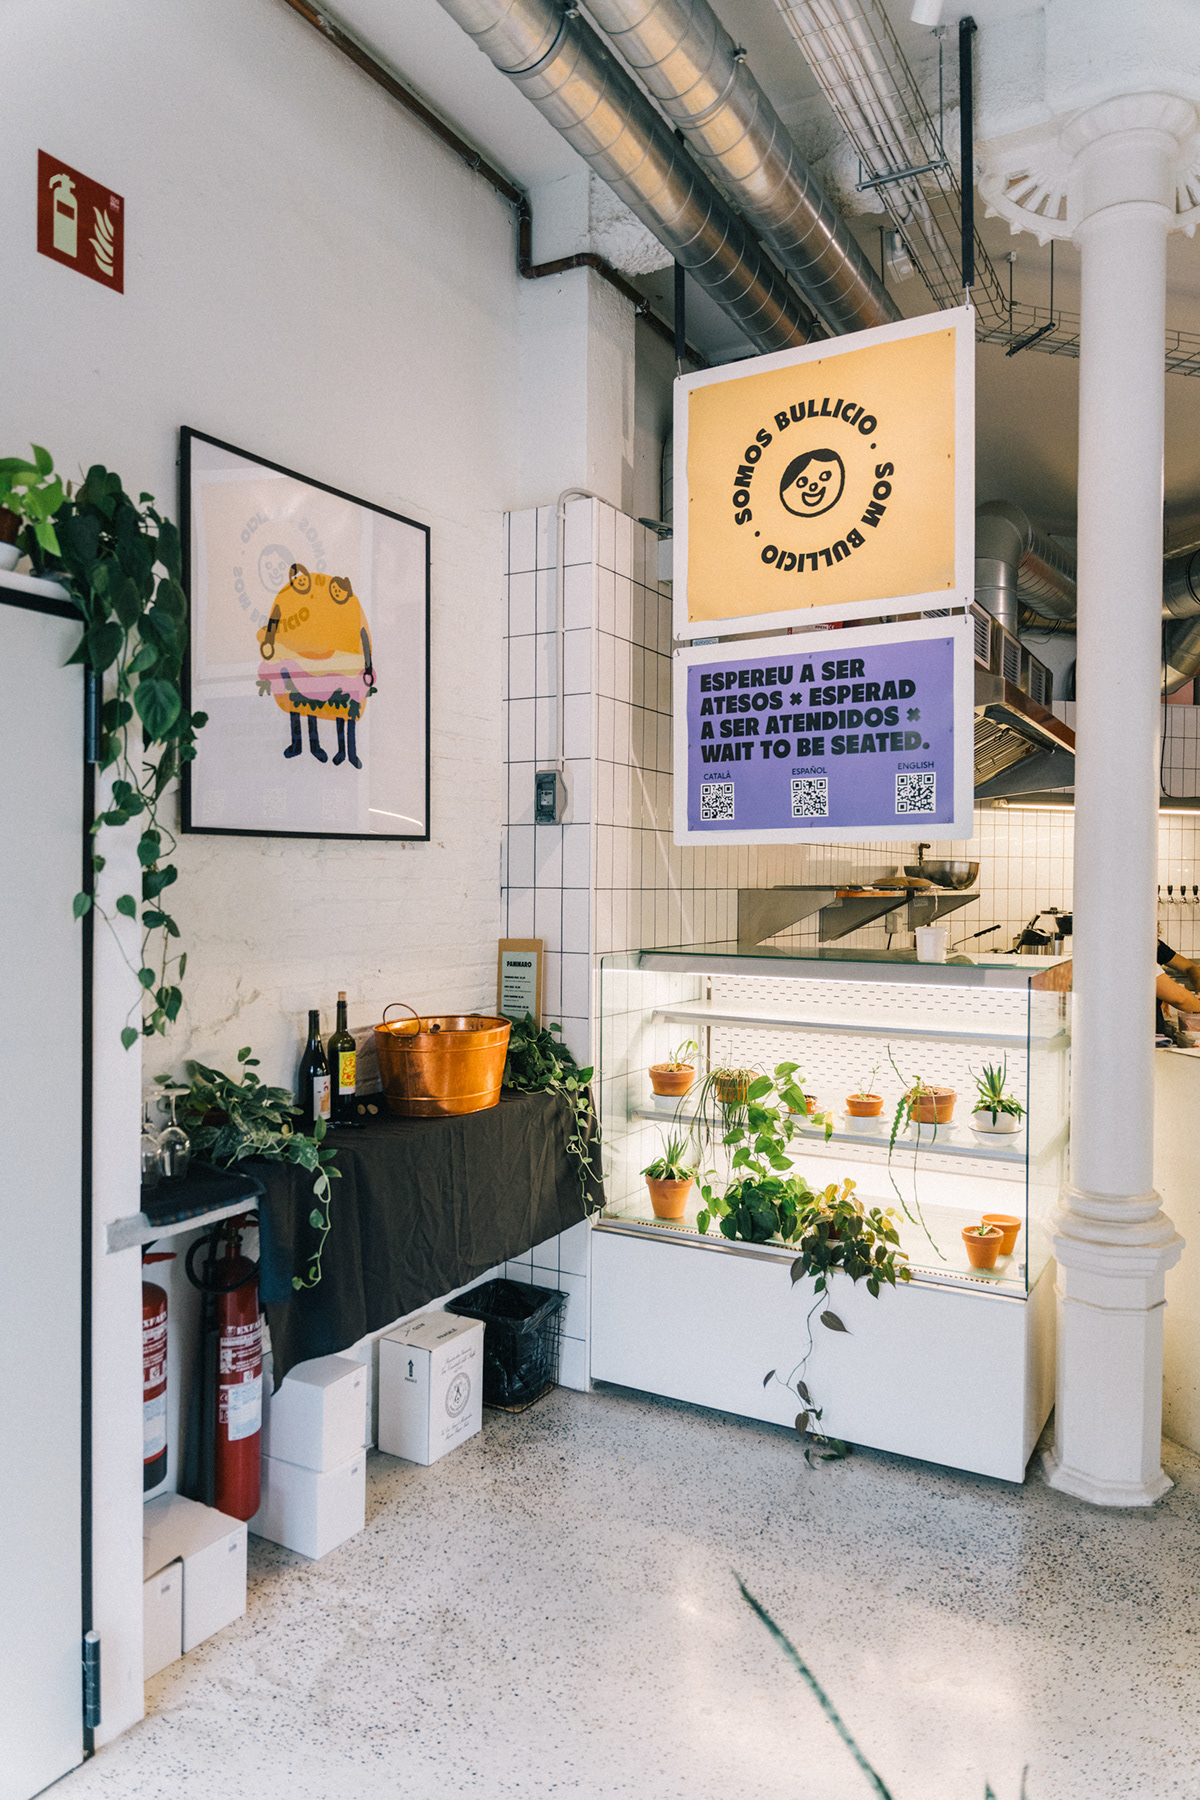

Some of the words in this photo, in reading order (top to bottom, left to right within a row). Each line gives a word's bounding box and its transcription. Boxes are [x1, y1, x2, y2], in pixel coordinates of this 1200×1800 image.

[732, 428, 773, 526] SOMOS
[773, 397, 878, 436] BULLICIO
[860, 461, 895, 528] SOM
[761, 527, 866, 573] BULLICIO
[700, 665, 794, 693] ESPEREU
[799, 663, 815, 683] A
[821, 658, 865, 681] SER
[700, 690, 783, 716] ATESOS
[809, 679, 916, 707] ESPERAD
[700, 721, 714, 740] A
[720, 716, 760, 739] SER
[765, 705, 899, 735] ATENDIDOS
[701, 742, 755, 763] WAIT
[760, 738, 791, 760] TO
[797, 737, 825, 757] BE
[830, 731, 930, 756] SEATED.
[703, 769, 731, 781] CATALÀ
[791, 765, 827, 776] ESPAÑOL
[897, 760, 935, 770] ENGLISH
